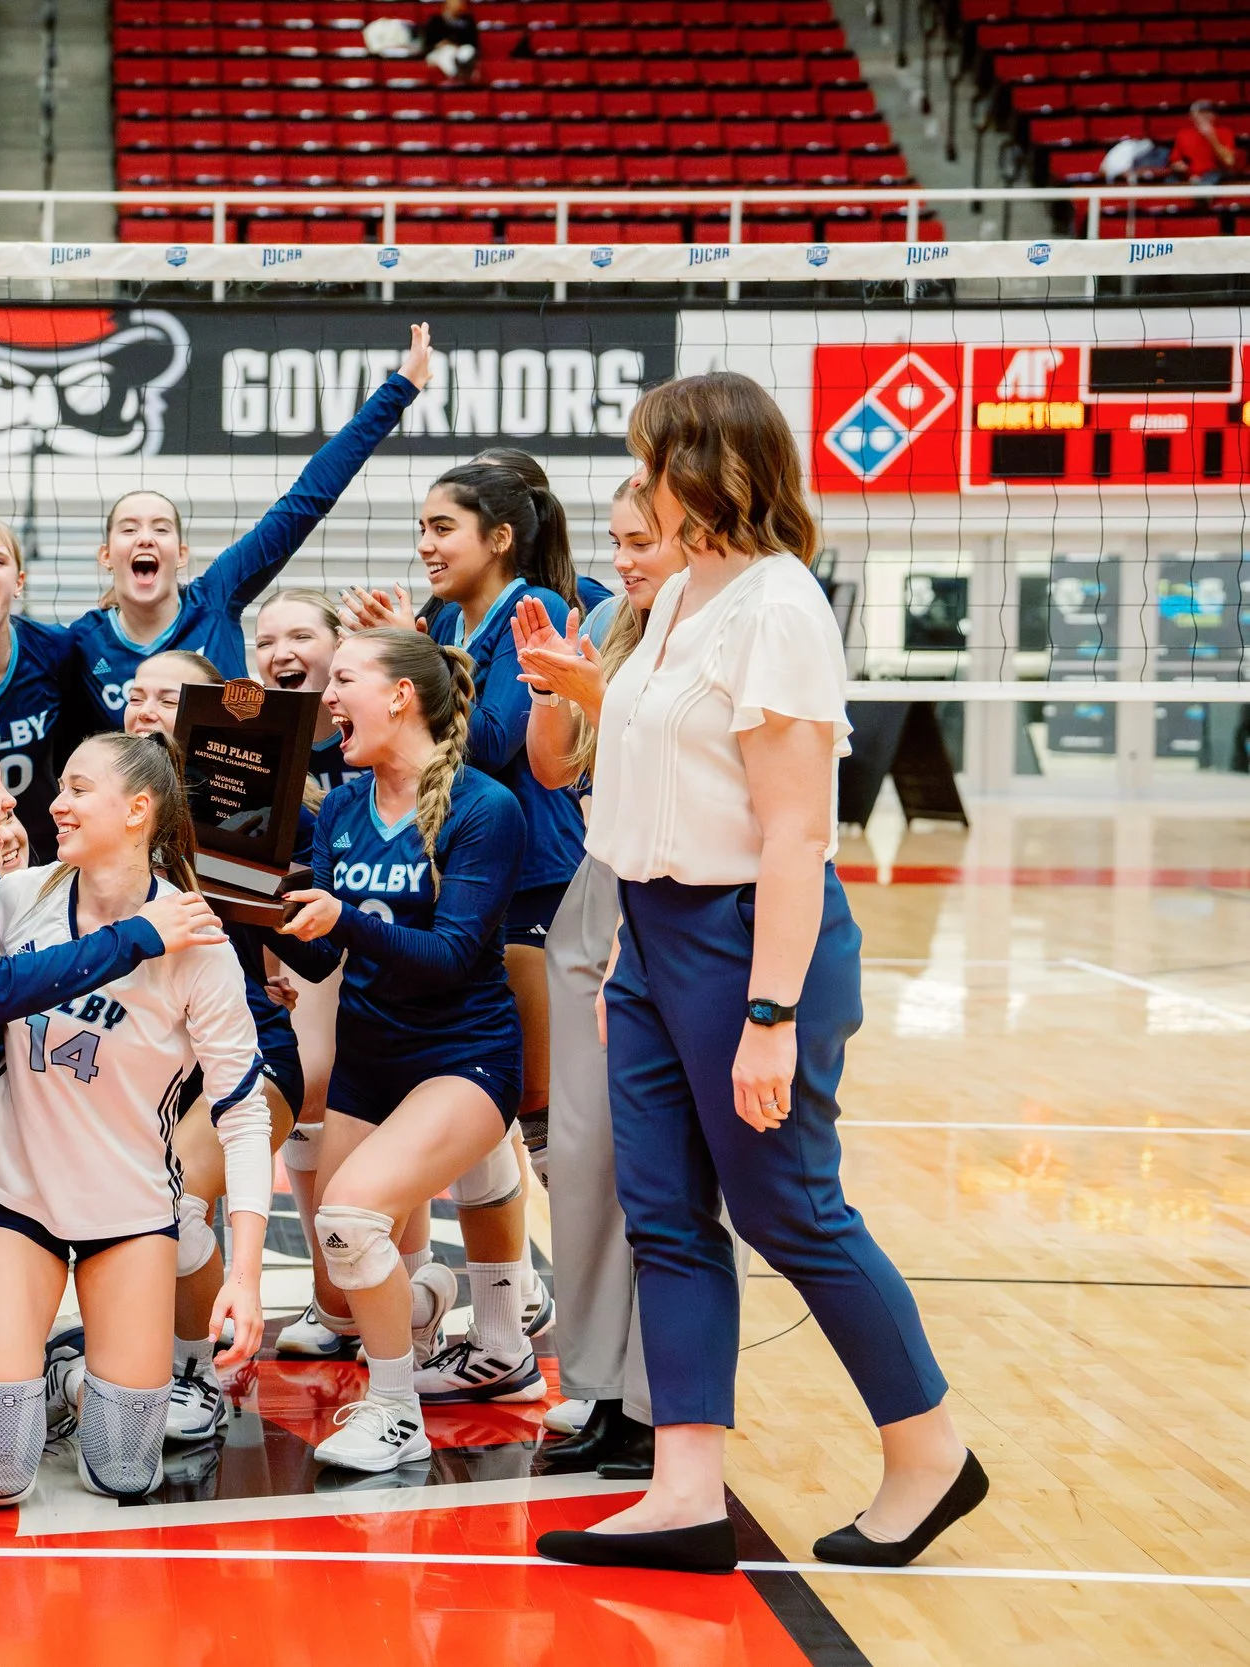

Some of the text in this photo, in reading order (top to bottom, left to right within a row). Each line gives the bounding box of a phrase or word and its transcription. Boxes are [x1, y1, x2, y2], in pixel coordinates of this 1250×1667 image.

[50, 247, 91, 266] NJCAA
[262, 249, 303, 267] NJCAA
[474, 249, 515, 268] NJCAA
[688, 248, 730, 266] NJCAA
[906, 246, 949, 266] NJCAA
[1128, 243, 1174, 264] NJCAA
[222, 682, 264, 703] NJCAA
[195, 750, 270, 774] NATIONAL CHAMPIONSHIP
[207, 741, 262, 764] 3RD PLACE
[210, 780, 246, 795] VOLLEYBALL
[214, 774, 244, 787] WOMEN'S
[210, 795, 237, 807] DIVISION
[216, 811, 230, 820] 2024
[333, 861, 429, 893] COLBY
[25, 1012, 101, 1084] 14
